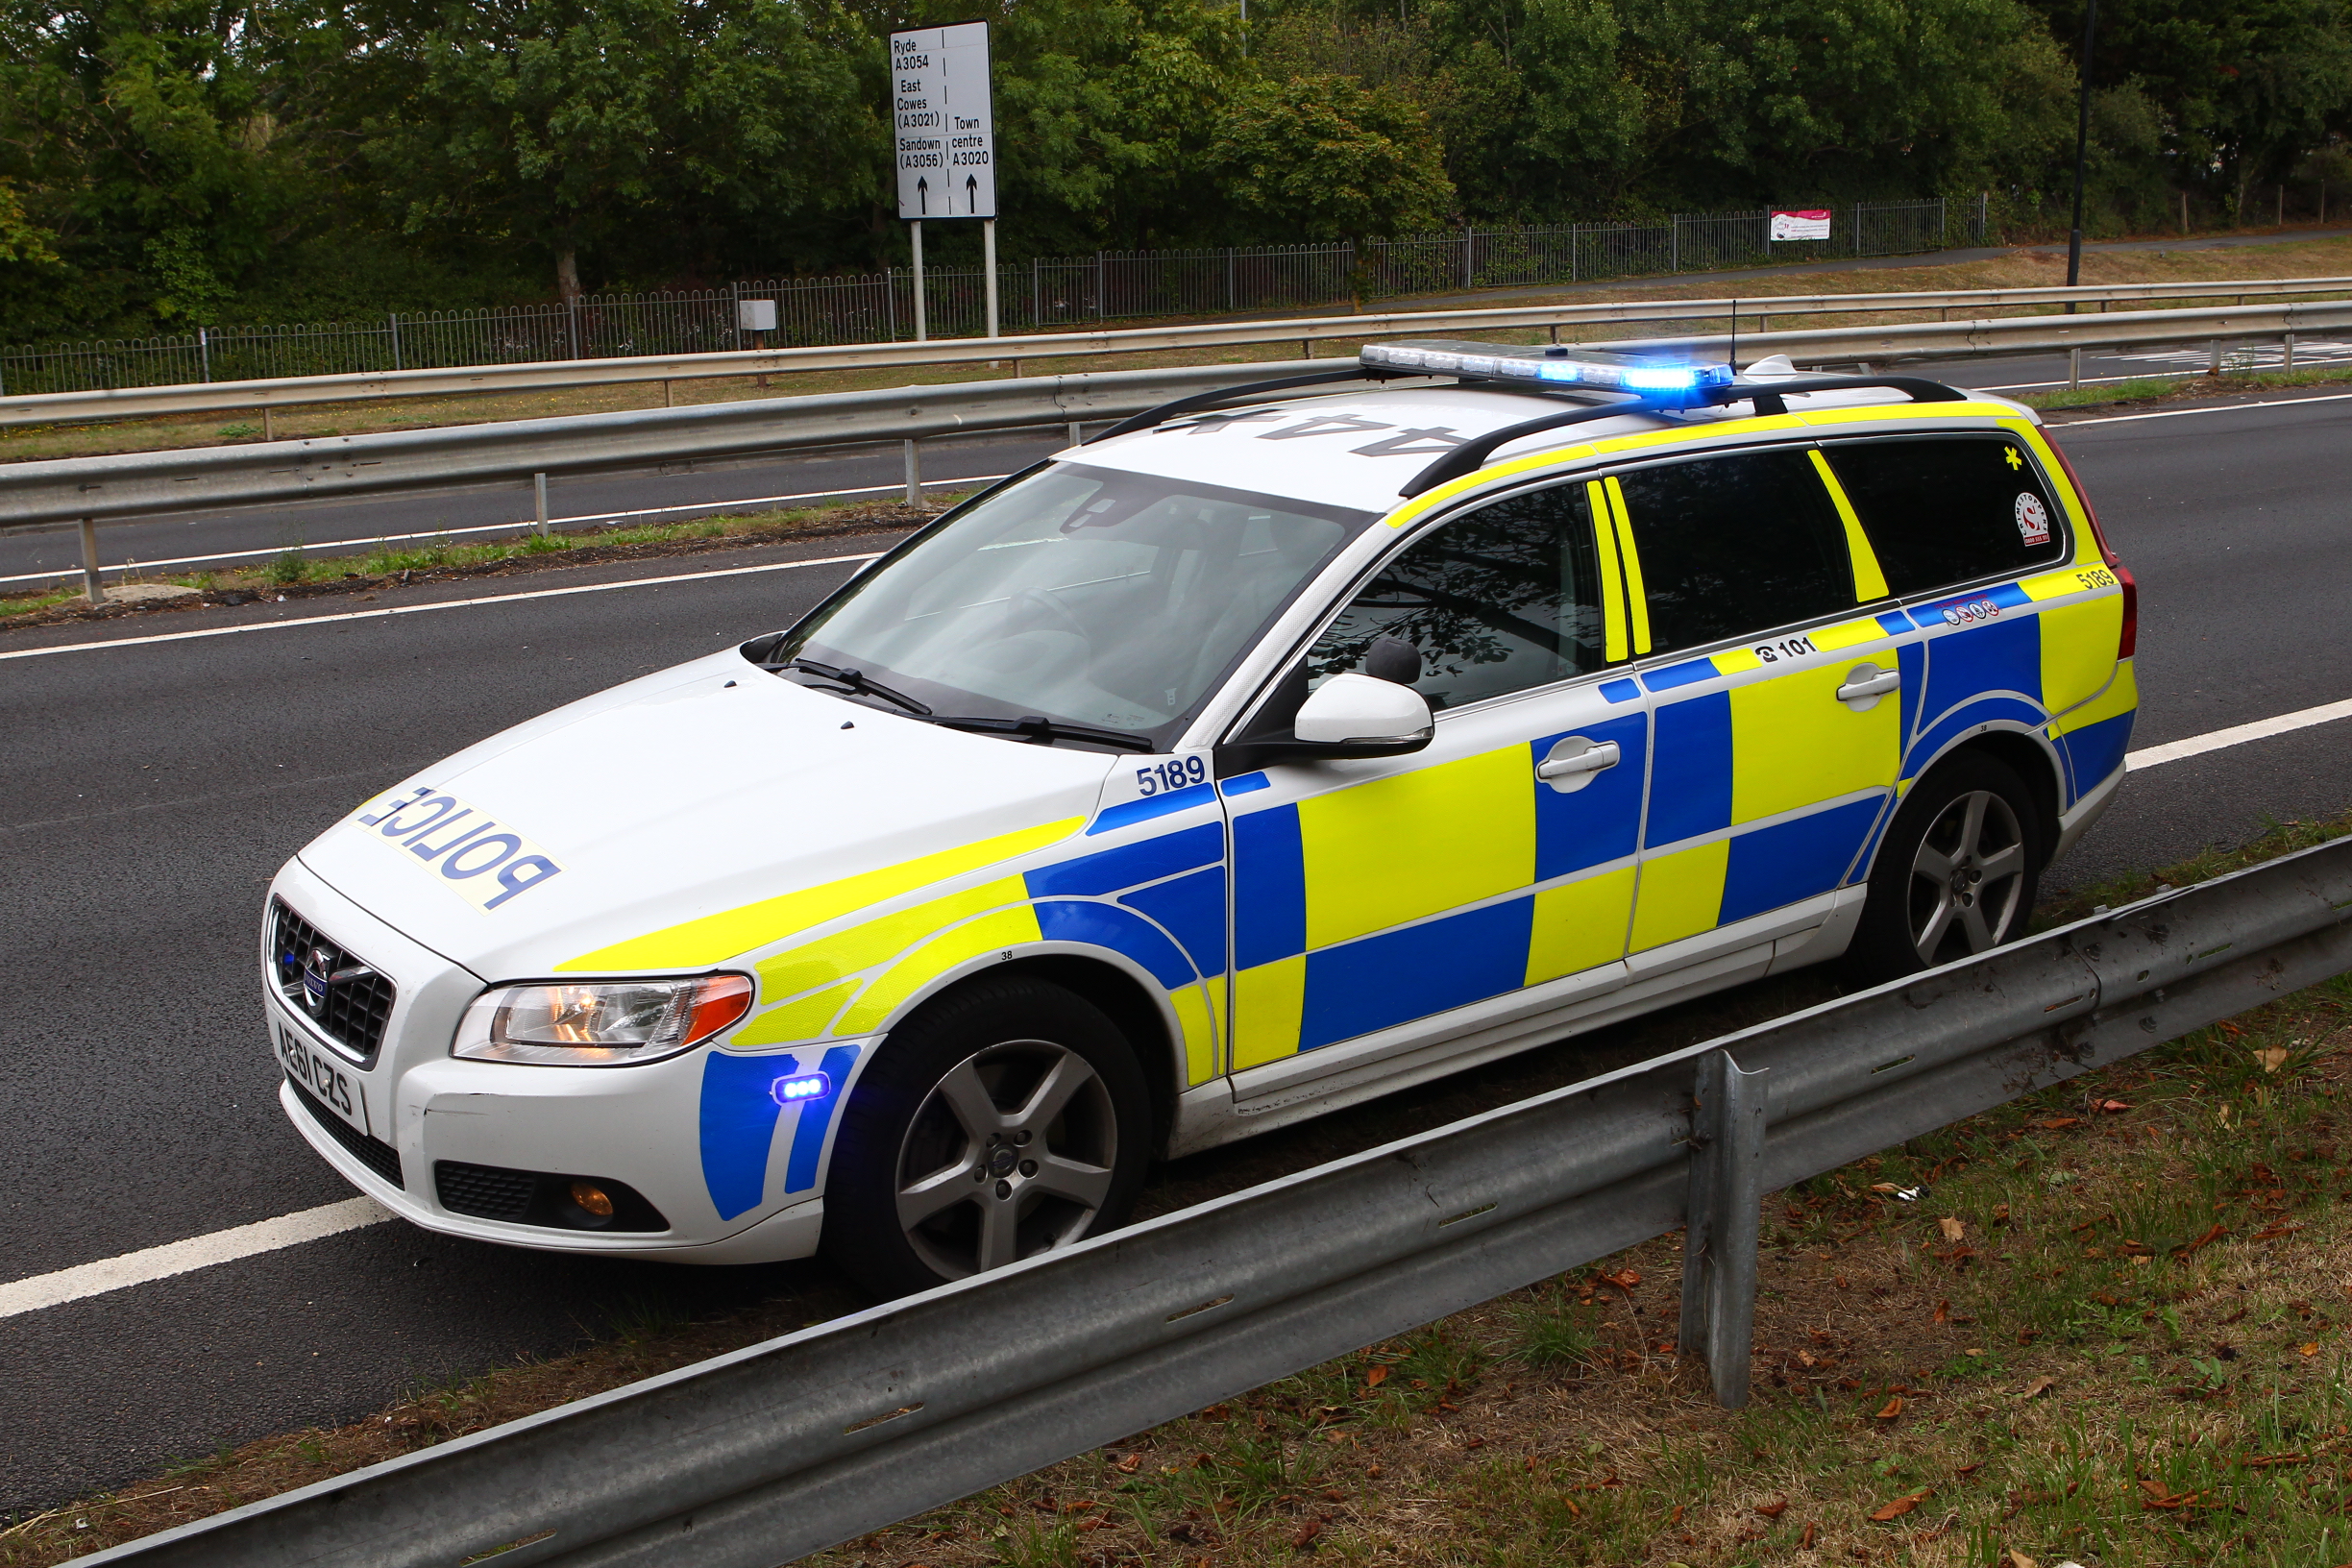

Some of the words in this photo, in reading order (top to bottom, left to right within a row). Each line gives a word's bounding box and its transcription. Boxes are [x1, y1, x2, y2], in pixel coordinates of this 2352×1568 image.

[894, 38, 917, 55] Ryde
[895, 55, 929, 71] A3054
[901, 79, 921, 92] East
[897, 98, 927, 110] Cowes
[898, 110, 940, 130] (A3021)
[954, 116, 980, 130] Town
[900, 136, 941, 151] Sandown
[952, 134, 983, 148] centre
[900, 152, 943, 170] (A3056)
[953, 151, 989, 165] A3020
[2075, 570, 2114, 589] 5189
[1778, 637, 1817, 657] 101
[1137, 755, 1205, 796] 5189
[1001, 950, 1013, 961] 38
[304, 971, 324, 992] VOLVO
[278, 1021, 313, 1086] AE61
[313, 1055, 353, 1116] CZS
